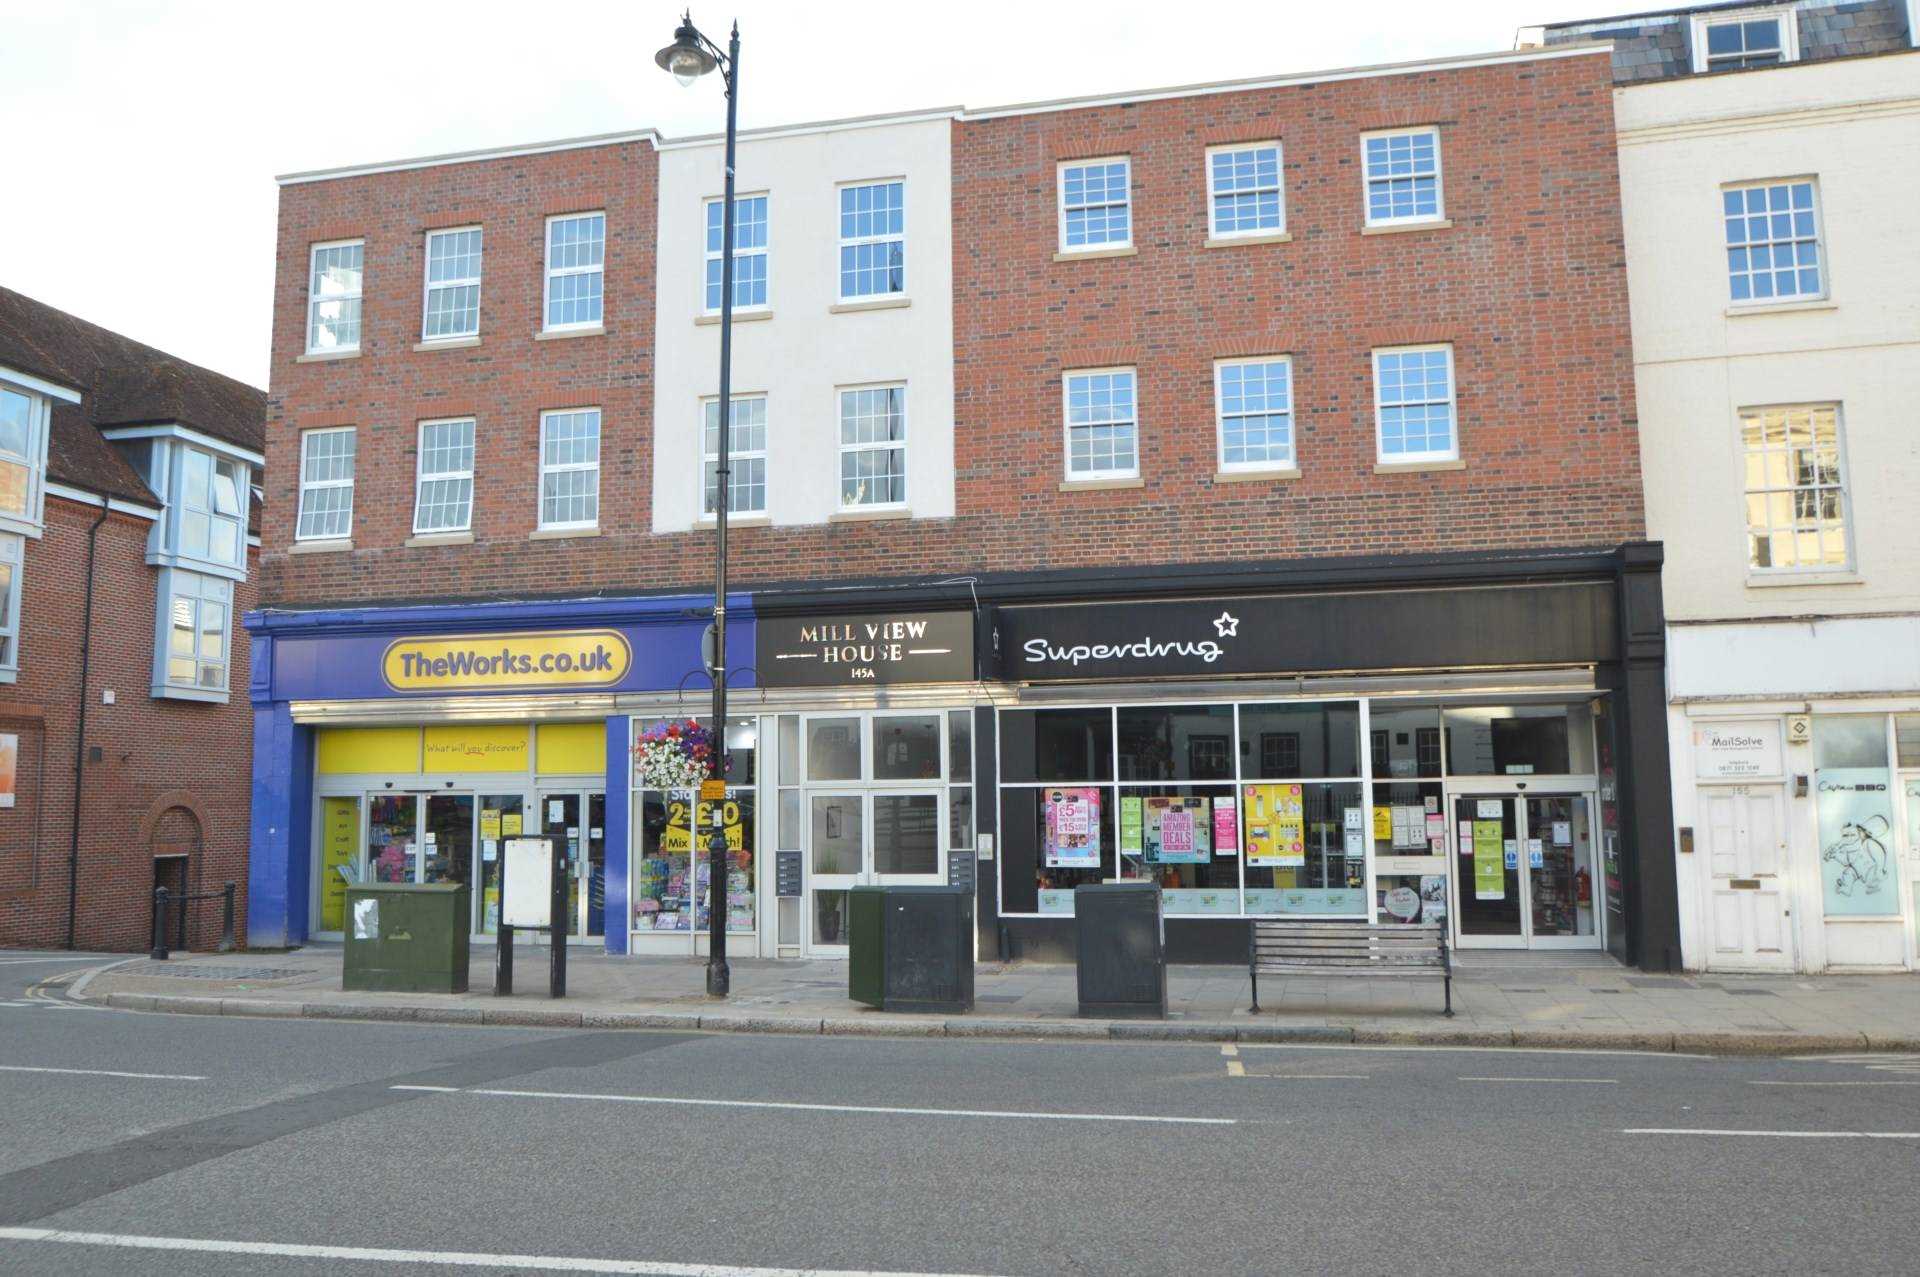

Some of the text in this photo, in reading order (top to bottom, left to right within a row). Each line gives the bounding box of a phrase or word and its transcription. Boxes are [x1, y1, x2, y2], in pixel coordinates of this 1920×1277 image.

[800, 621, 928, 642] MILL VIEW
[822, 644, 903, 663] HOUSE
[1023, 637, 1224, 666] Superdrug
[400, 645, 612, 678] TheWorks.co.uk
[851, 668, 875, 679] 145A
[426, 741, 528, 754] What will you discover?
[1711, 737, 1764, 747] MailSolve
[696, 801, 739, 826] £0
[668, 838, 688, 849] Mix
[1163, 831, 1192, 844] DEALS
